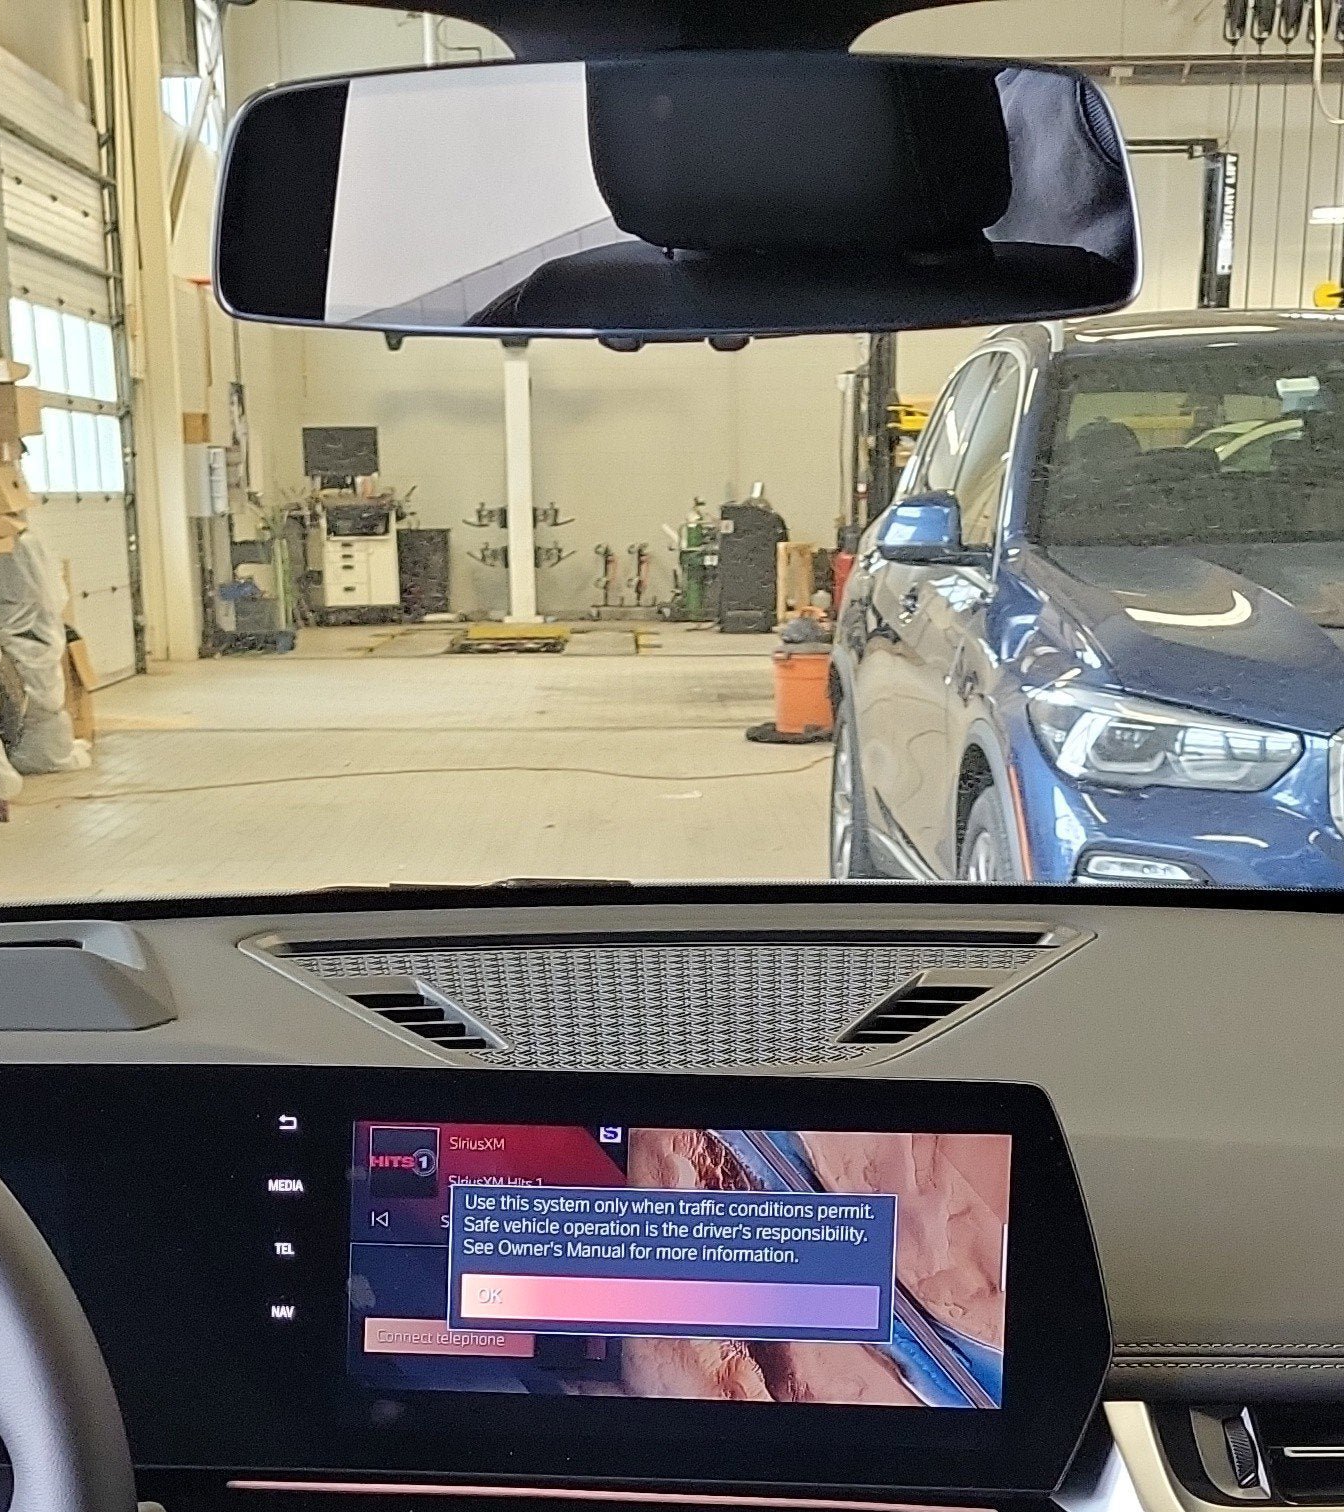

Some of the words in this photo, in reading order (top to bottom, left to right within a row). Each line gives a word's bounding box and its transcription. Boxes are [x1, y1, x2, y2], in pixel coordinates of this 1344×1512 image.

[449, 1136, 505, 1151] SiriusXM
[370, 1155, 415, 1168] HITS
[418, 1156, 429, 1169] 1
[268, 1179, 304, 1192] MEDIA
[464, 1194, 496, 1210] Use
[500, 1195, 529, 1211] this
[533, 1197, 590, 1215] system
[594, 1197, 629, 1217] only
[632, 1199, 675, 1215] when
[679, 1199, 725, 1216] traffic
[728, 1201, 813, 1219] conditions
[817, 1203, 875, 1221] permit.
[463, 1216, 500, 1233] Safe
[503, 1218, 560, 1235] vehicle
[563, 1220, 640, 1237] operation
[645, 1221, 658, 1237] is
[662, 1222, 689, 1238] the
[692, 1223, 752, 1240] driver's
[755, 1224, 868, 1245] responsibility.
[274, 1242, 295, 1255] TEL
[463, 1239, 494, 1255] See
[498, 1239, 563, 1257] Owner's
[566, 1242, 626, 1259] Manual
[629, 1243, 652, 1259] for
[656, 1246, 698, 1261] more
[702, 1245, 799, 1263] information.
[478, 1288, 503, 1304] OK
[271, 1305, 295, 1318] NAV
[377, 1328, 433, 1344] Connect
[436, 1331, 505, 1348] telephone
